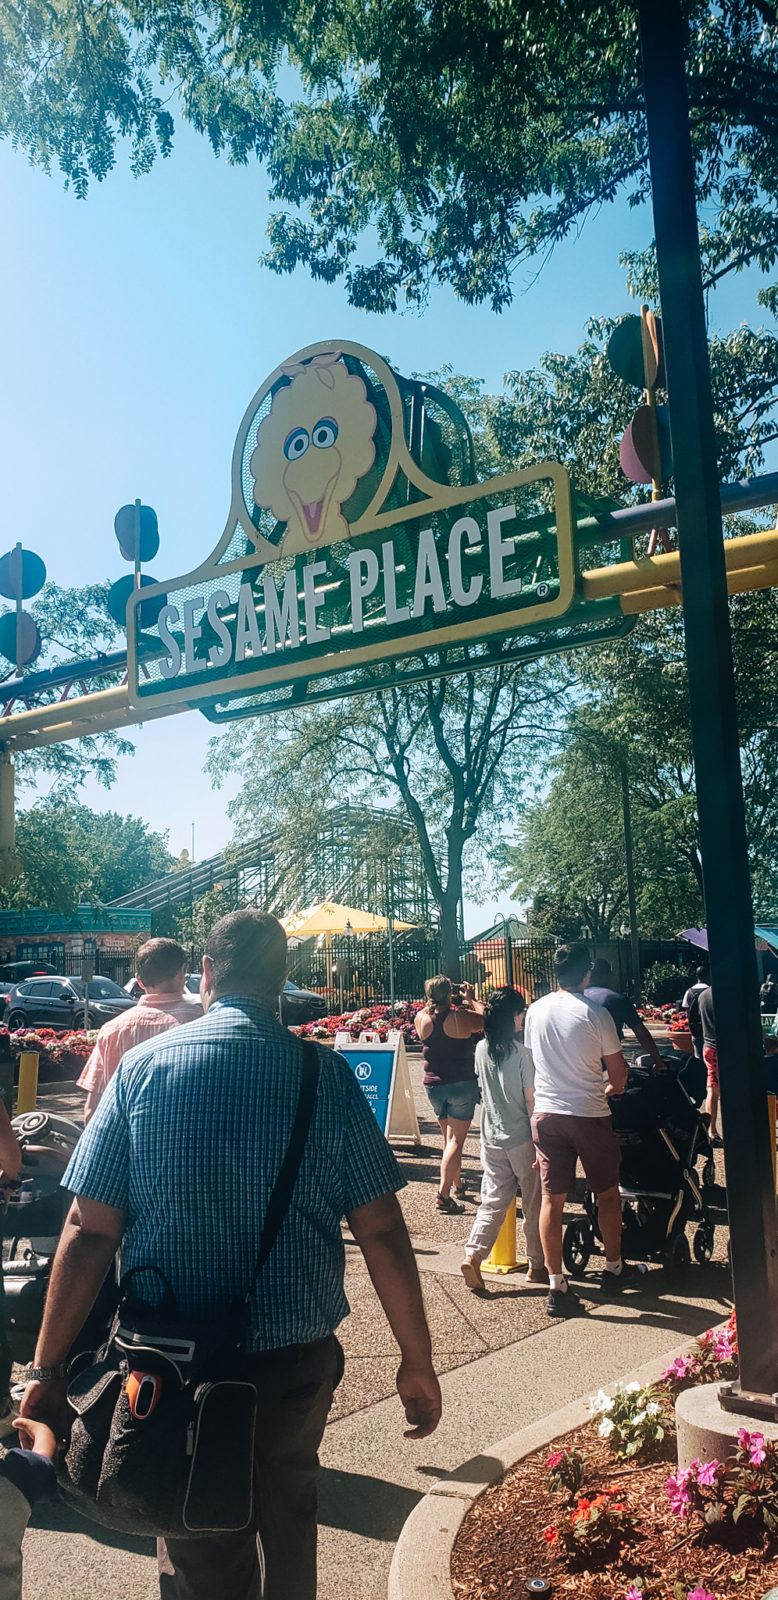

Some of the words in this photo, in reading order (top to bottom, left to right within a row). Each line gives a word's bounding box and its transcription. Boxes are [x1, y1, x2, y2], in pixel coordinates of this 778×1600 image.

[158, 561, 331, 679] SESAME
[349, 506, 521, 632] PLACE
[360, 1085, 378, 1093] TSIDE
